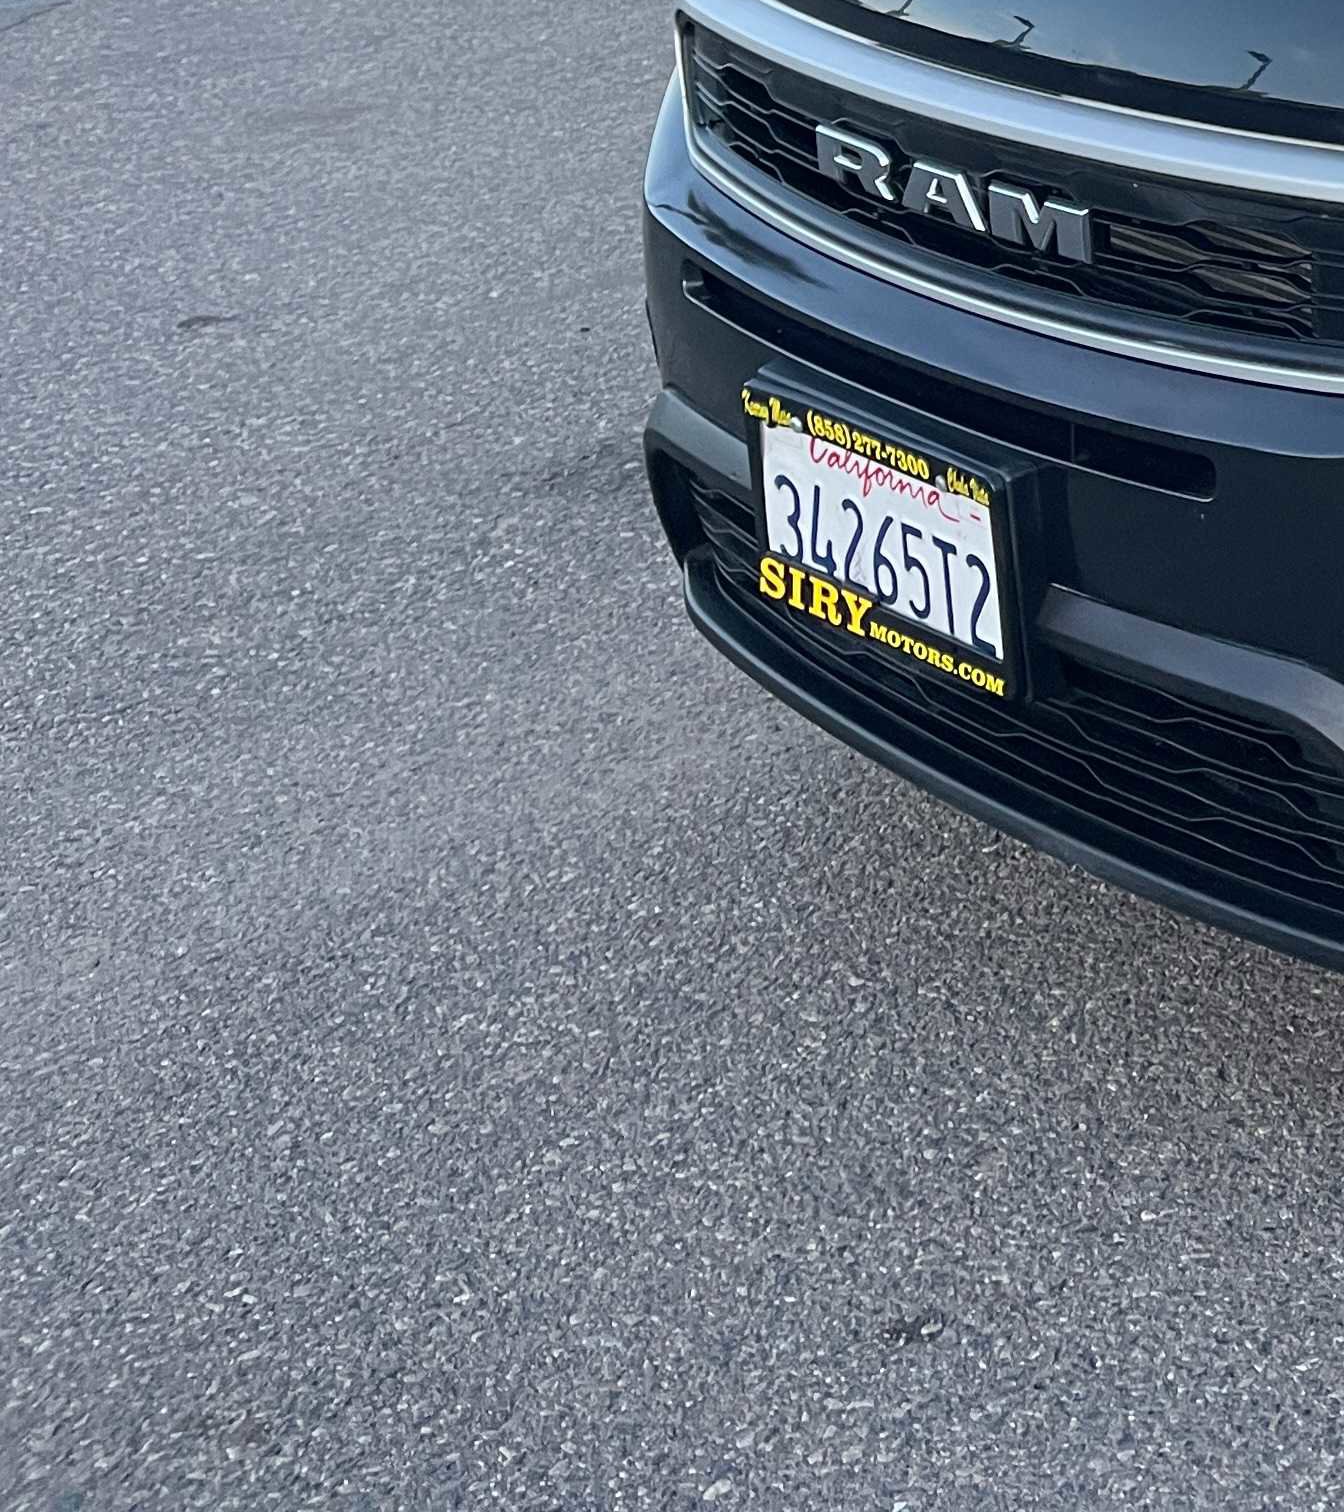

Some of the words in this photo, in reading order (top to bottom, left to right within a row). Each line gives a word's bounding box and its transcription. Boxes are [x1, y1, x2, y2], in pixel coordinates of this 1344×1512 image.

[815, 124, 1093, 265] RAM
[806, 409, 852, 450] (858)
[852, 431, 930, 481] 277-7300
[809, 436, 960, 524] California
[759, 556, 873, 637] SIRY
[869, 620, 1006, 697] MOTORS.COM
[774, 474, 997, 657] 34265T2
